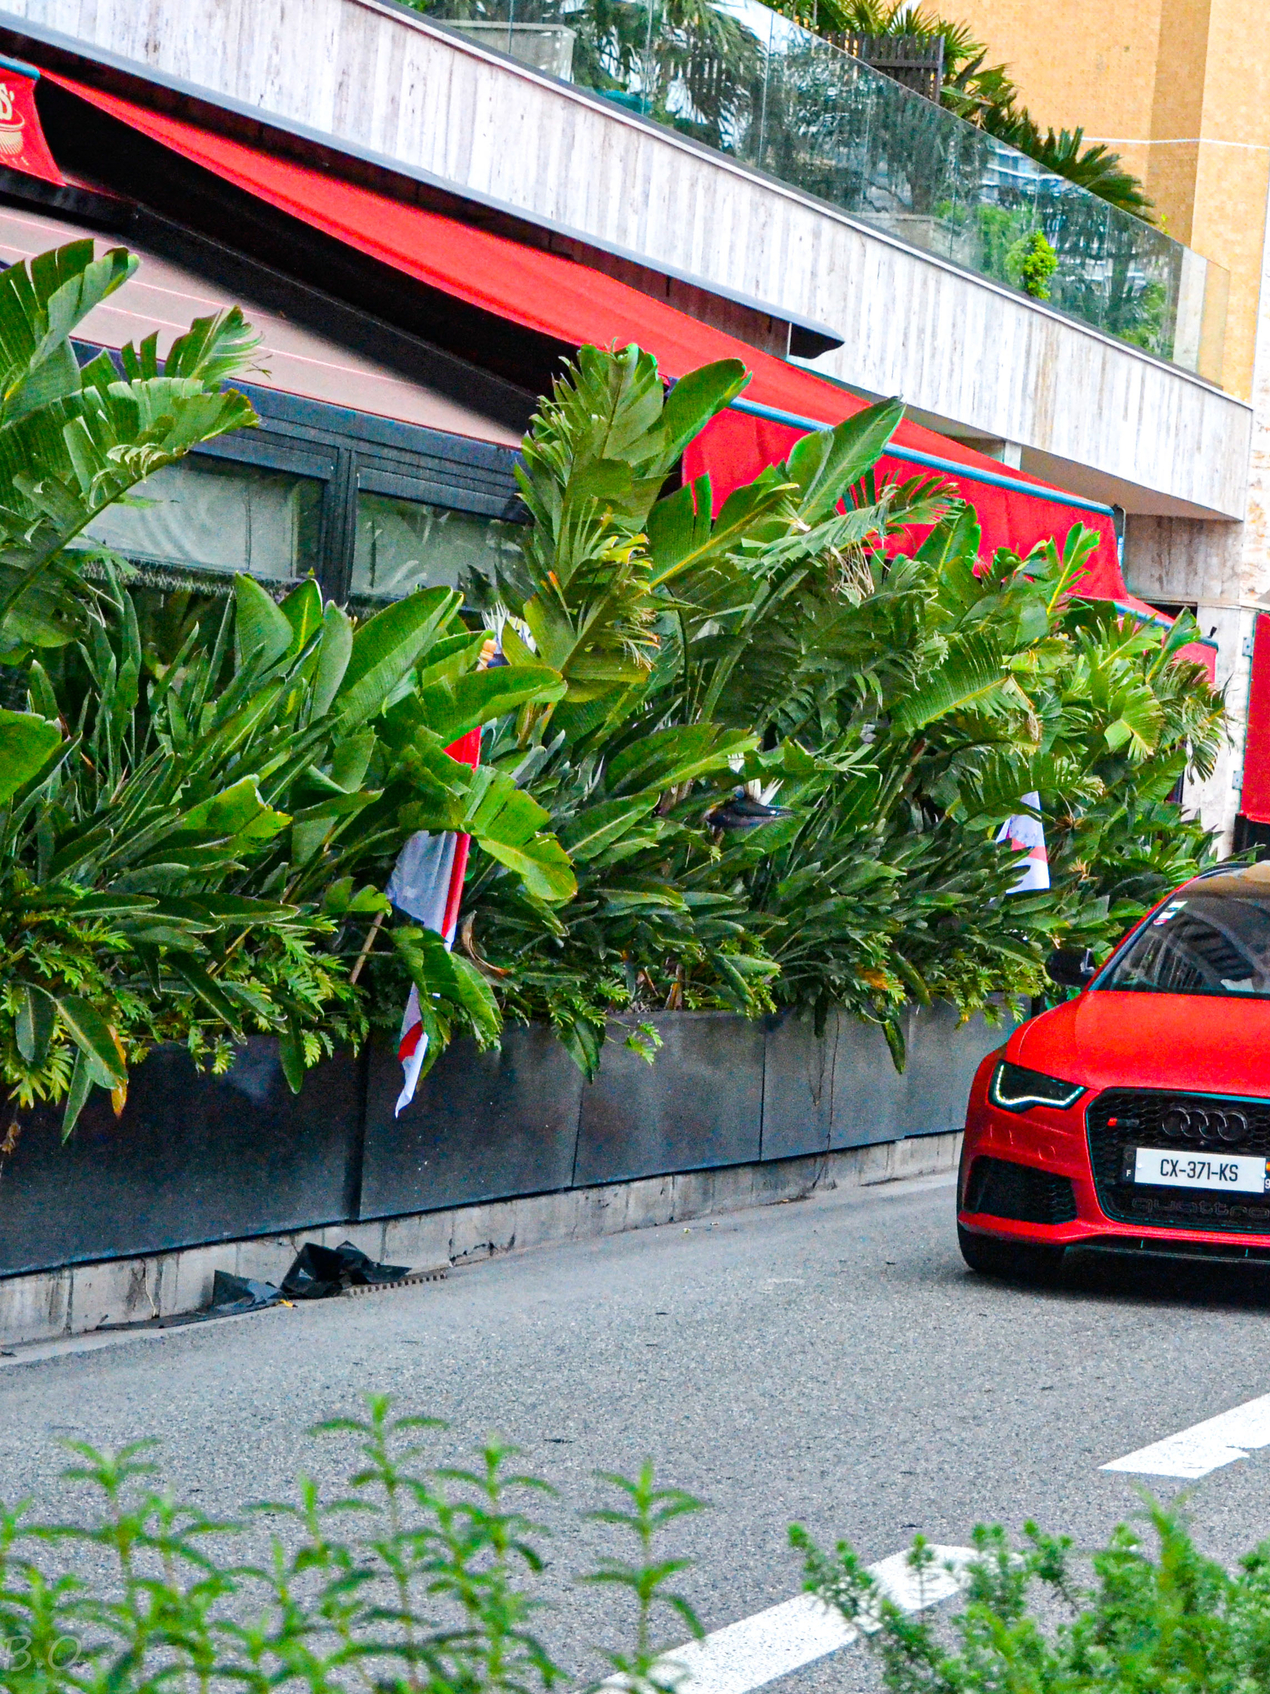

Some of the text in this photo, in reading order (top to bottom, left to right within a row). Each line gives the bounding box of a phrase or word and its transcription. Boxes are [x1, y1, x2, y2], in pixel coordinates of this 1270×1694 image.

[1125, 1169, 1132, 1178] F
[1159, 1158, 1239, 1182] CX-371-KS
[1131, 1197, 1270, 1219] quattro
